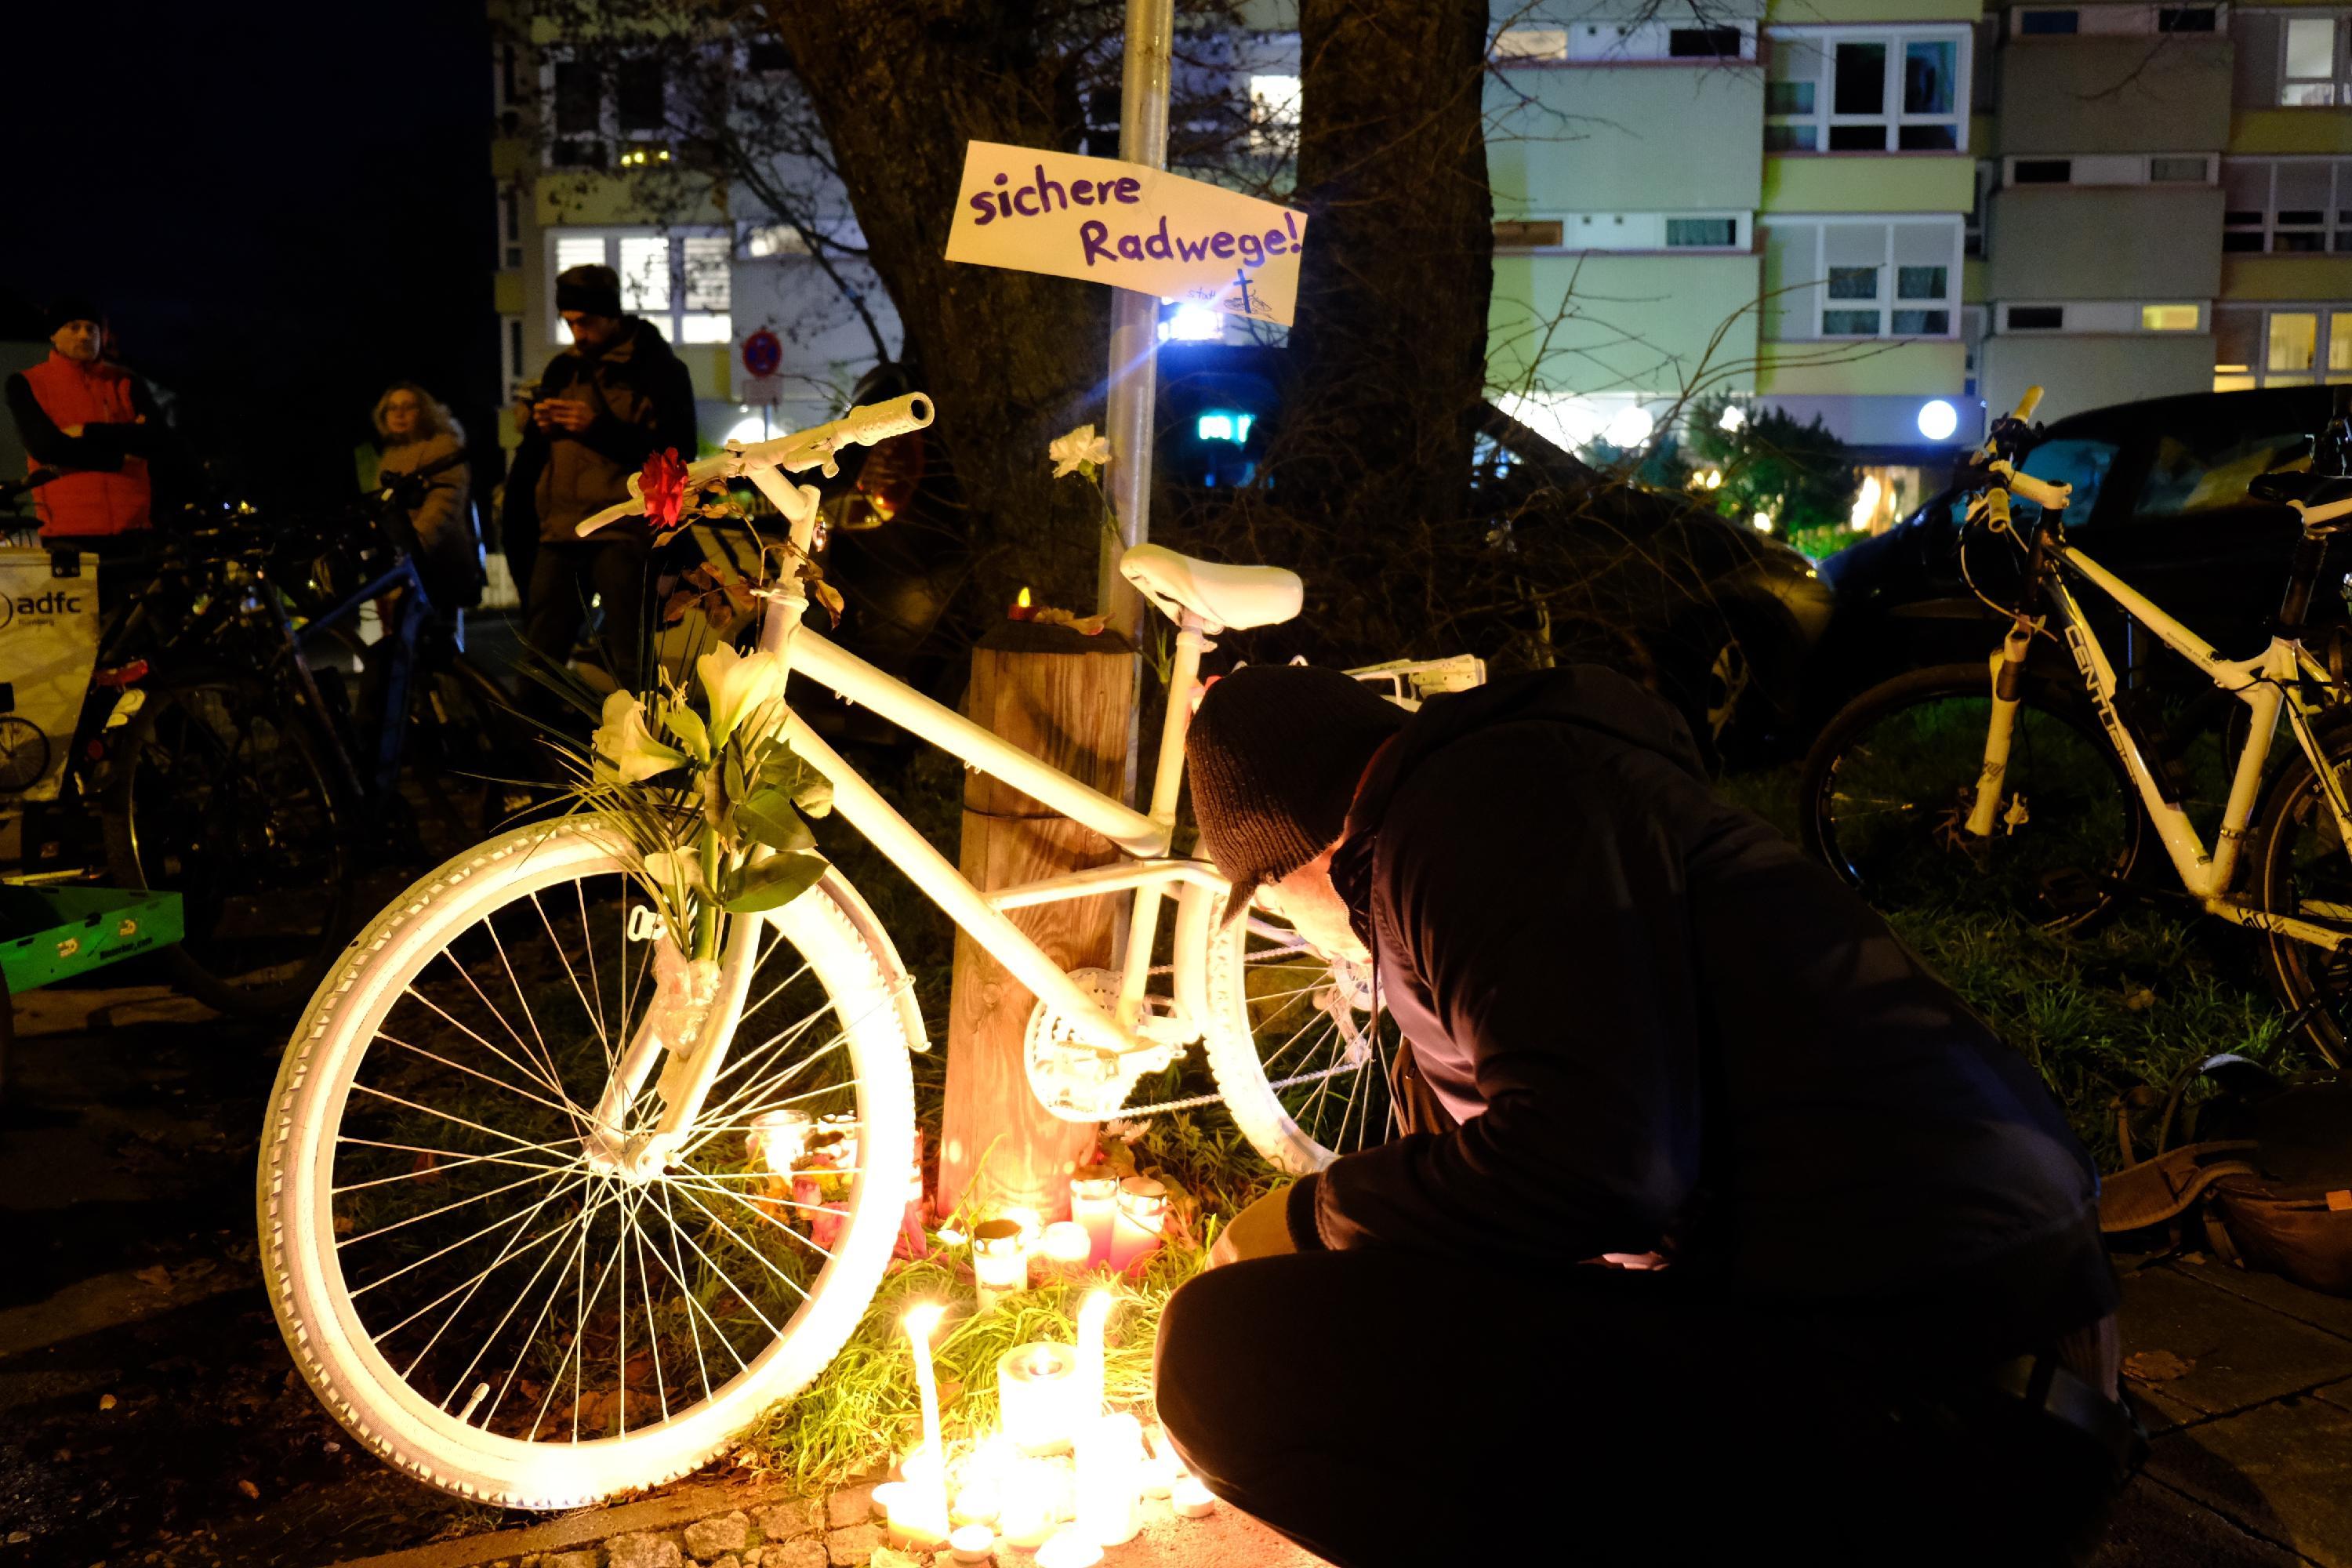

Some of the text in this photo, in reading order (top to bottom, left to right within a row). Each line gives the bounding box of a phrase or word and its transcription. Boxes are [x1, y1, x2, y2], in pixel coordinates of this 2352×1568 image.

[969, 164, 1142, 226] sichere
[1080, 212, 1302, 267] Radwege!
[17, 591, 82, 615] adfc
